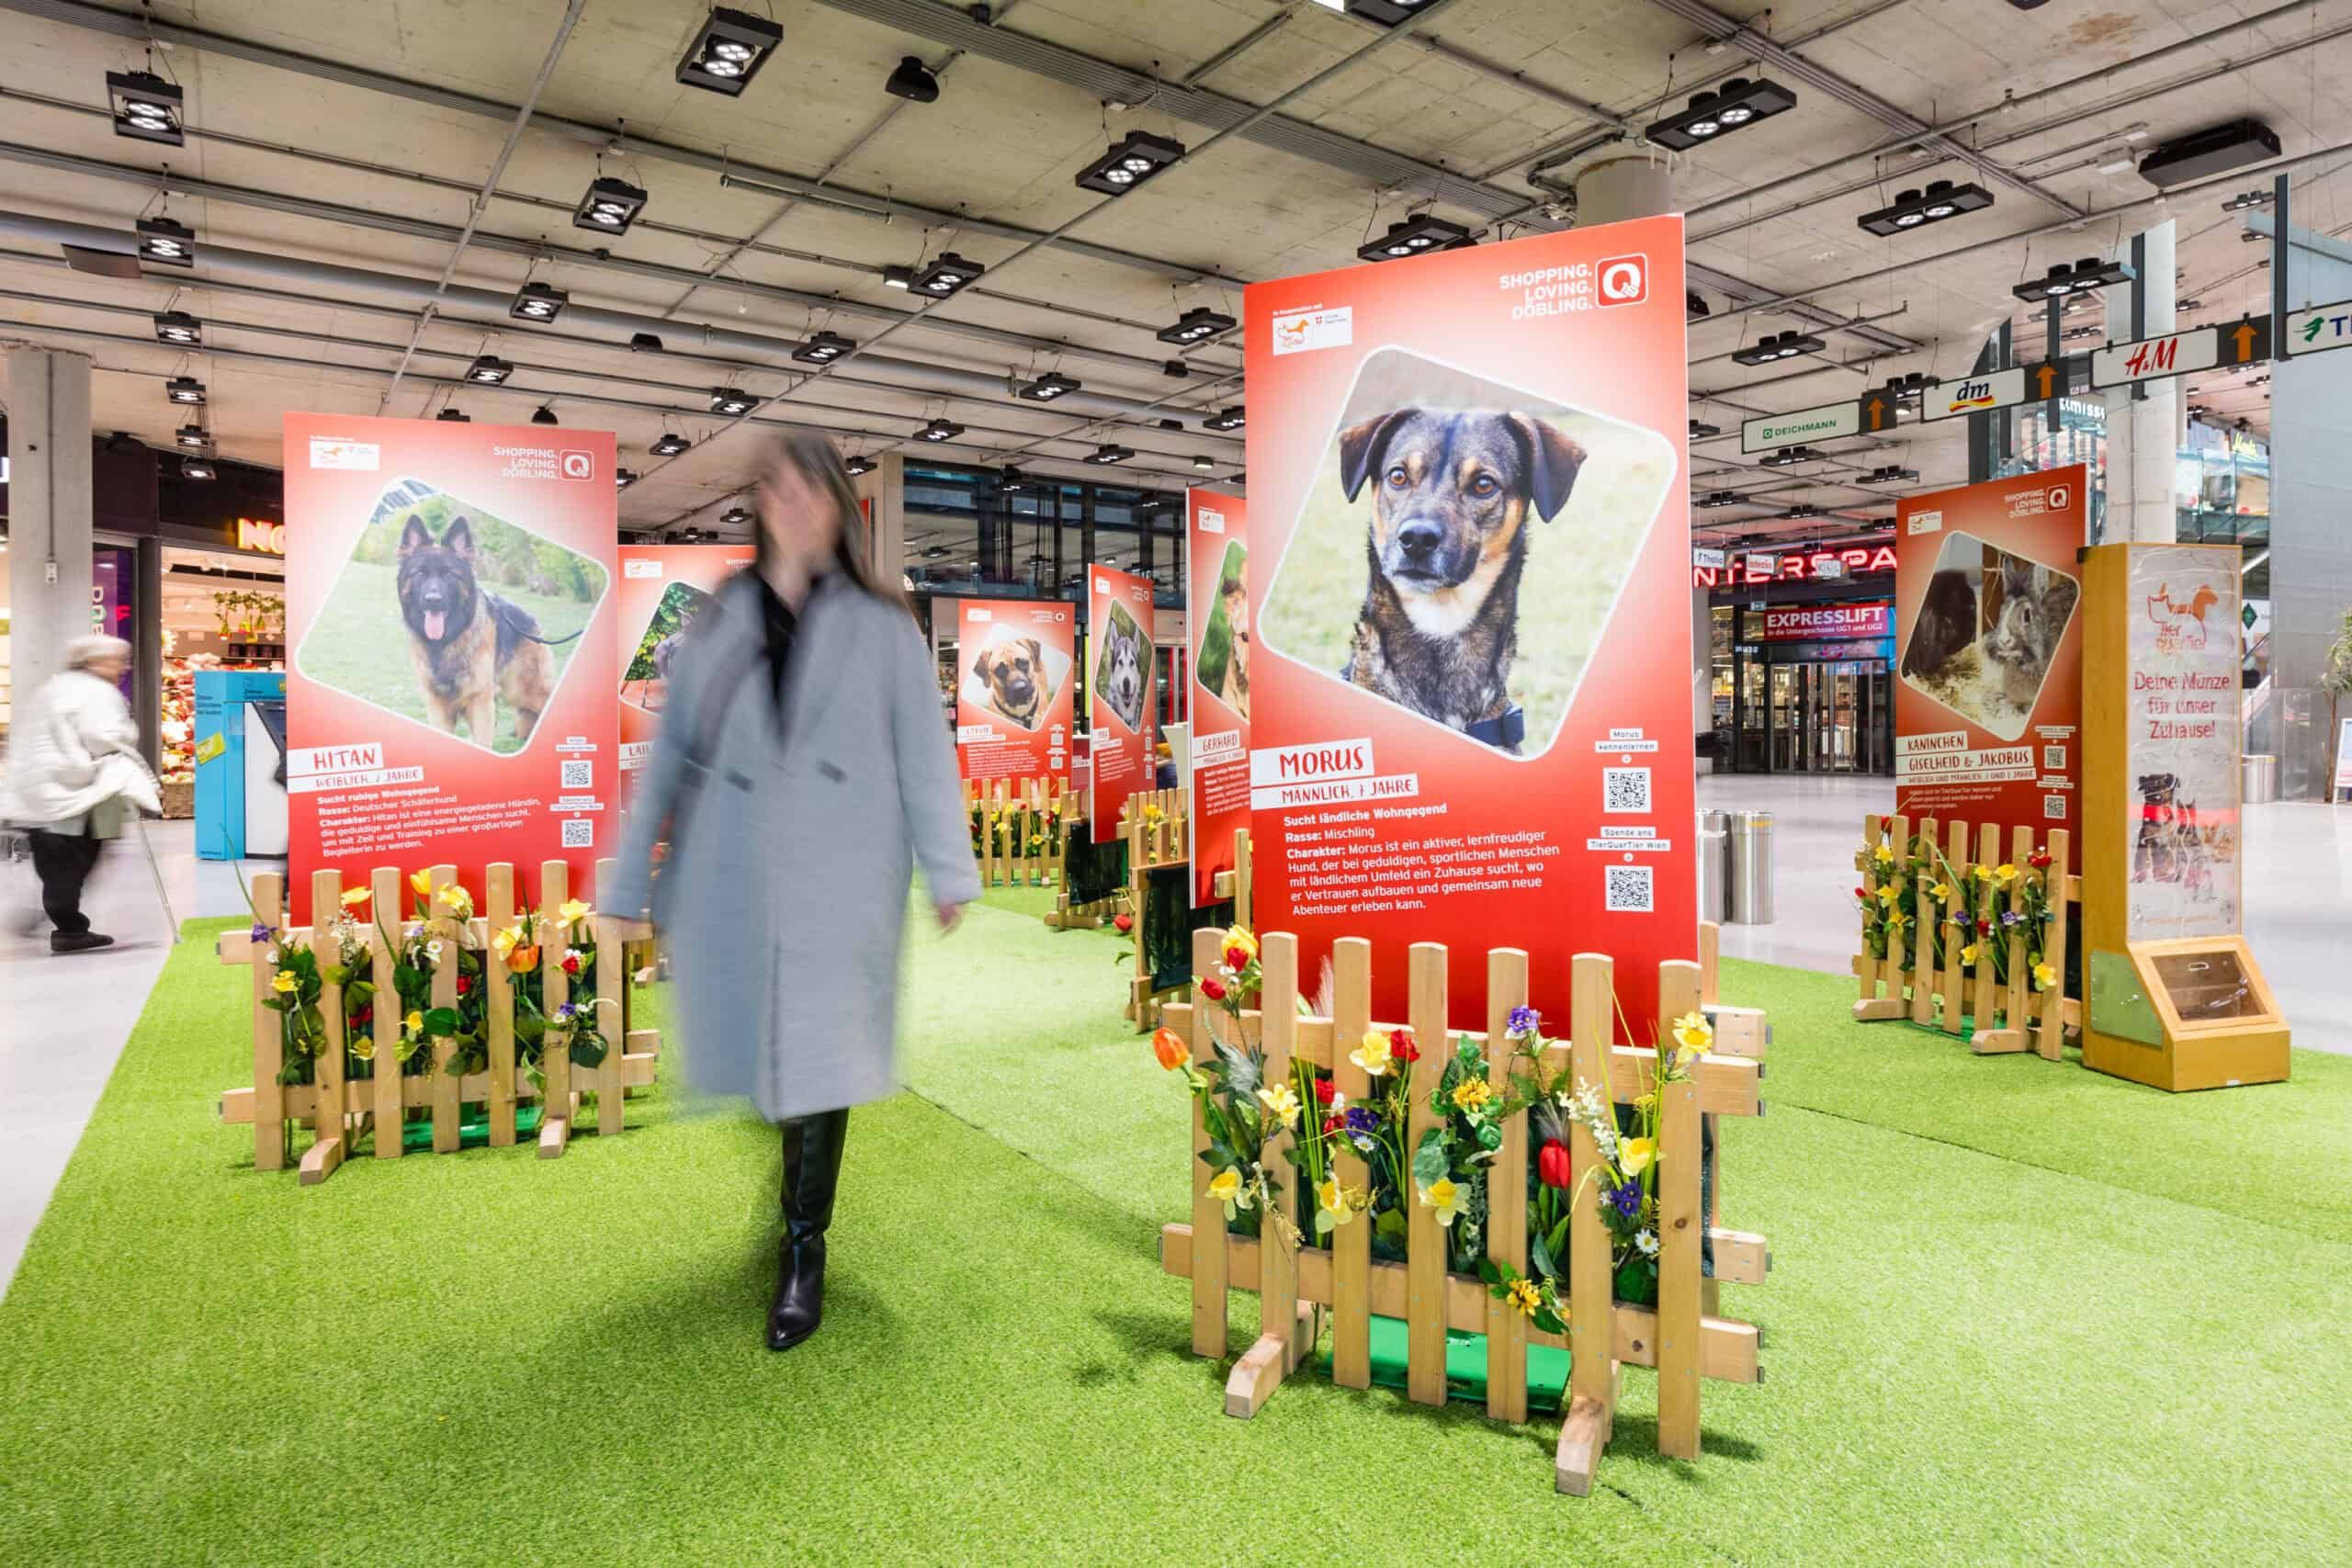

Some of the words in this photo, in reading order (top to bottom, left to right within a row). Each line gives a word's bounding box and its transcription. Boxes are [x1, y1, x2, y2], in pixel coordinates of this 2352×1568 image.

[1499, 263, 1593, 289] SHOPPING.
[1524, 280, 1592, 303] LOVING.
[1511, 296, 1593, 320] DÖBLING.
[2123, 337, 2177, 377] H&M
[1956, 381, 1990, 401] dm
[1774, 419, 1837, 436] DEICHMANN
[493, 446, 559, 459] SHOPPING.
[1692, 546, 1896, 588] NTERSPA
[1767, 606, 1884, 628] EXPRESSLIFT
[1907, 735, 1964, 751] KANINCHEN
[313, 748, 376, 770] HITAN
[1279, 746, 1364, 779] MORUS
[1909, 755, 1960, 771] GISELHEID
[1979, 750, 2029, 767] JAKOBUS
[1371, 779, 1413, 796] JAHRE
[1283, 814, 1316, 827] Sucht
[1319, 809, 1370, 824] ländliche
[1374, 803, 1447, 818] Wohngegend
[1285, 832, 1322, 843] Rasse:
[1324, 827, 1375, 840] Mischling
[1286, 846, 1346, 860] Charakter:
[1349, 843, 1383, 854] Morus
[1385, 841, 1399, 852] ist
[1402, 840, 1419, 851] ein
[1422, 836, 1464, 850] aktiver,
[1467, 830, 1546, 847] lernfreudiger
[1288, 862, 1319, 874] Hund,
[1322, 860, 1339, 872] der
[1342, 859, 1359, 870] bei
[1363, 855, 1427, 871] geduldigen,
[1430, 850, 1496, 865] sportlichen
[1498, 845, 1560, 859] Menschen
[1289, 876, 1306, 888] mit
[1309, 873, 1368, 886] ländlichem
[1371, 869, 1410, 883] Umfeld
[1413, 868, 1431, 880] ein
[1434, 866, 1484, 879] Zuhause
[1487, 862, 1523, 874] sucht,
[1526, 862, 1544, 873] wo
[1291, 891, 1302, 902] er
[1305, 887, 1359, 901] Vertrauen
[1362, 885, 1413, 898] aufbauen
[1417, 882, 1439, 895] und
[1442, 879, 1510, 896] gemeinsam
[1511, 877, 1543, 888] neue
[1293, 902, 1348, 916] Abenteuer
[1351, 900, 1393, 913] erleben
[1396, 898, 1427, 910] kann.
